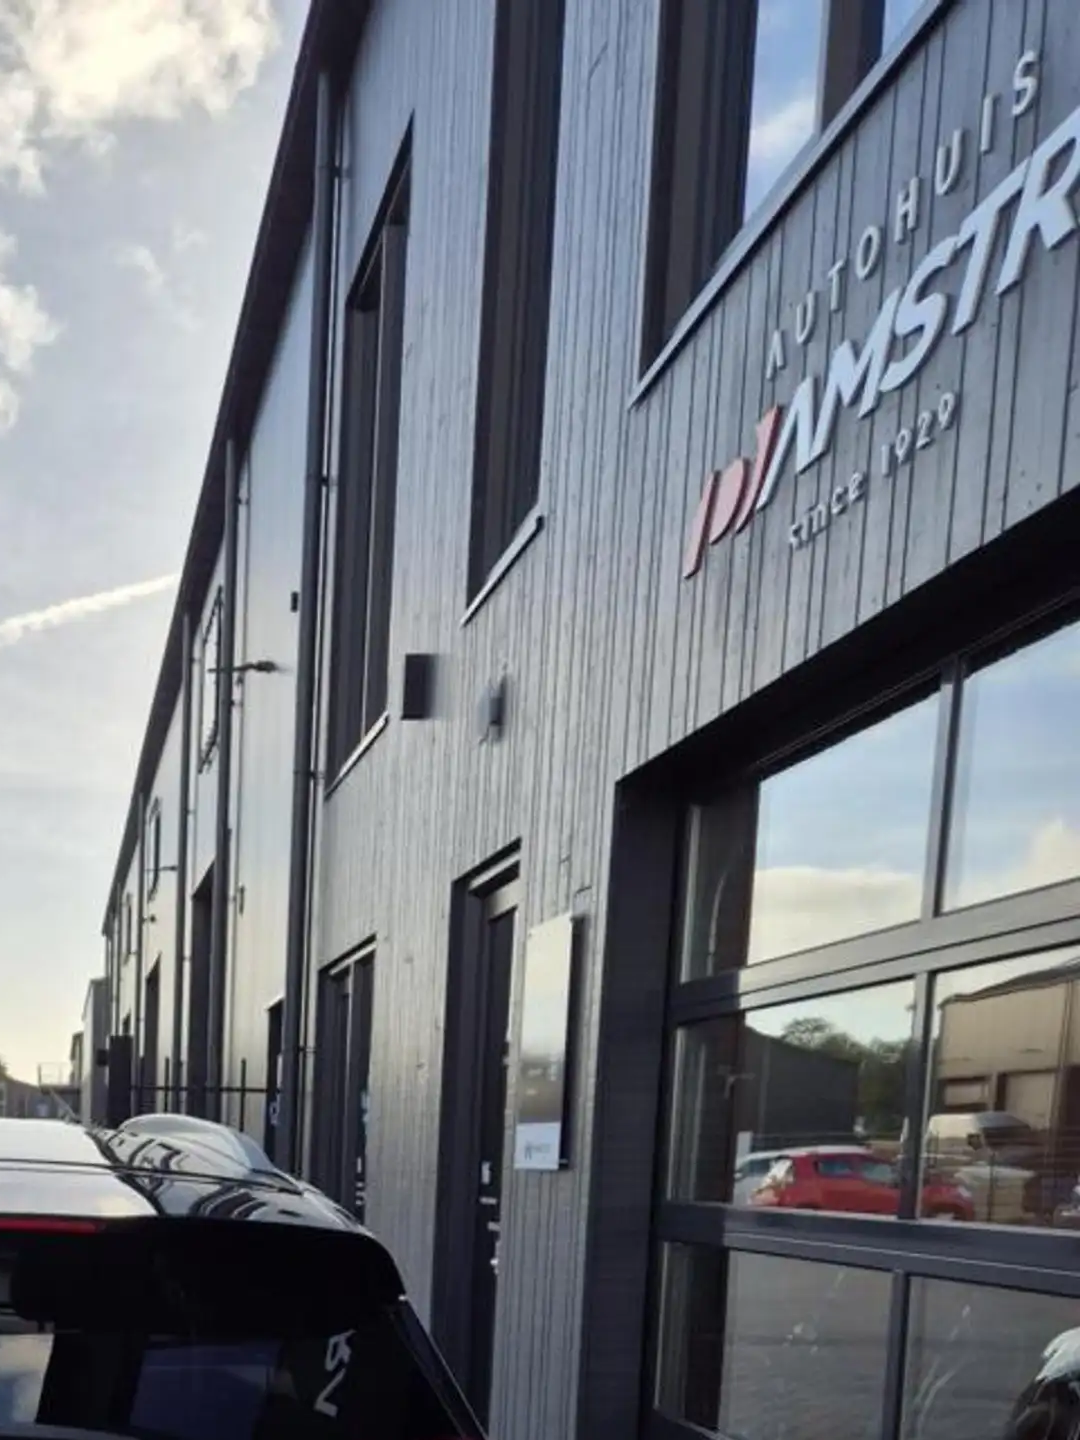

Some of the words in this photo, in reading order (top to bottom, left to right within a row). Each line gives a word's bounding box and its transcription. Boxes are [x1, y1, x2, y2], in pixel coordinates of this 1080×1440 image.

[766, 49, 1039, 380] AUTOHUIS
[789, 471, 866, 549] since
[881, 391, 956, 478] 1929
